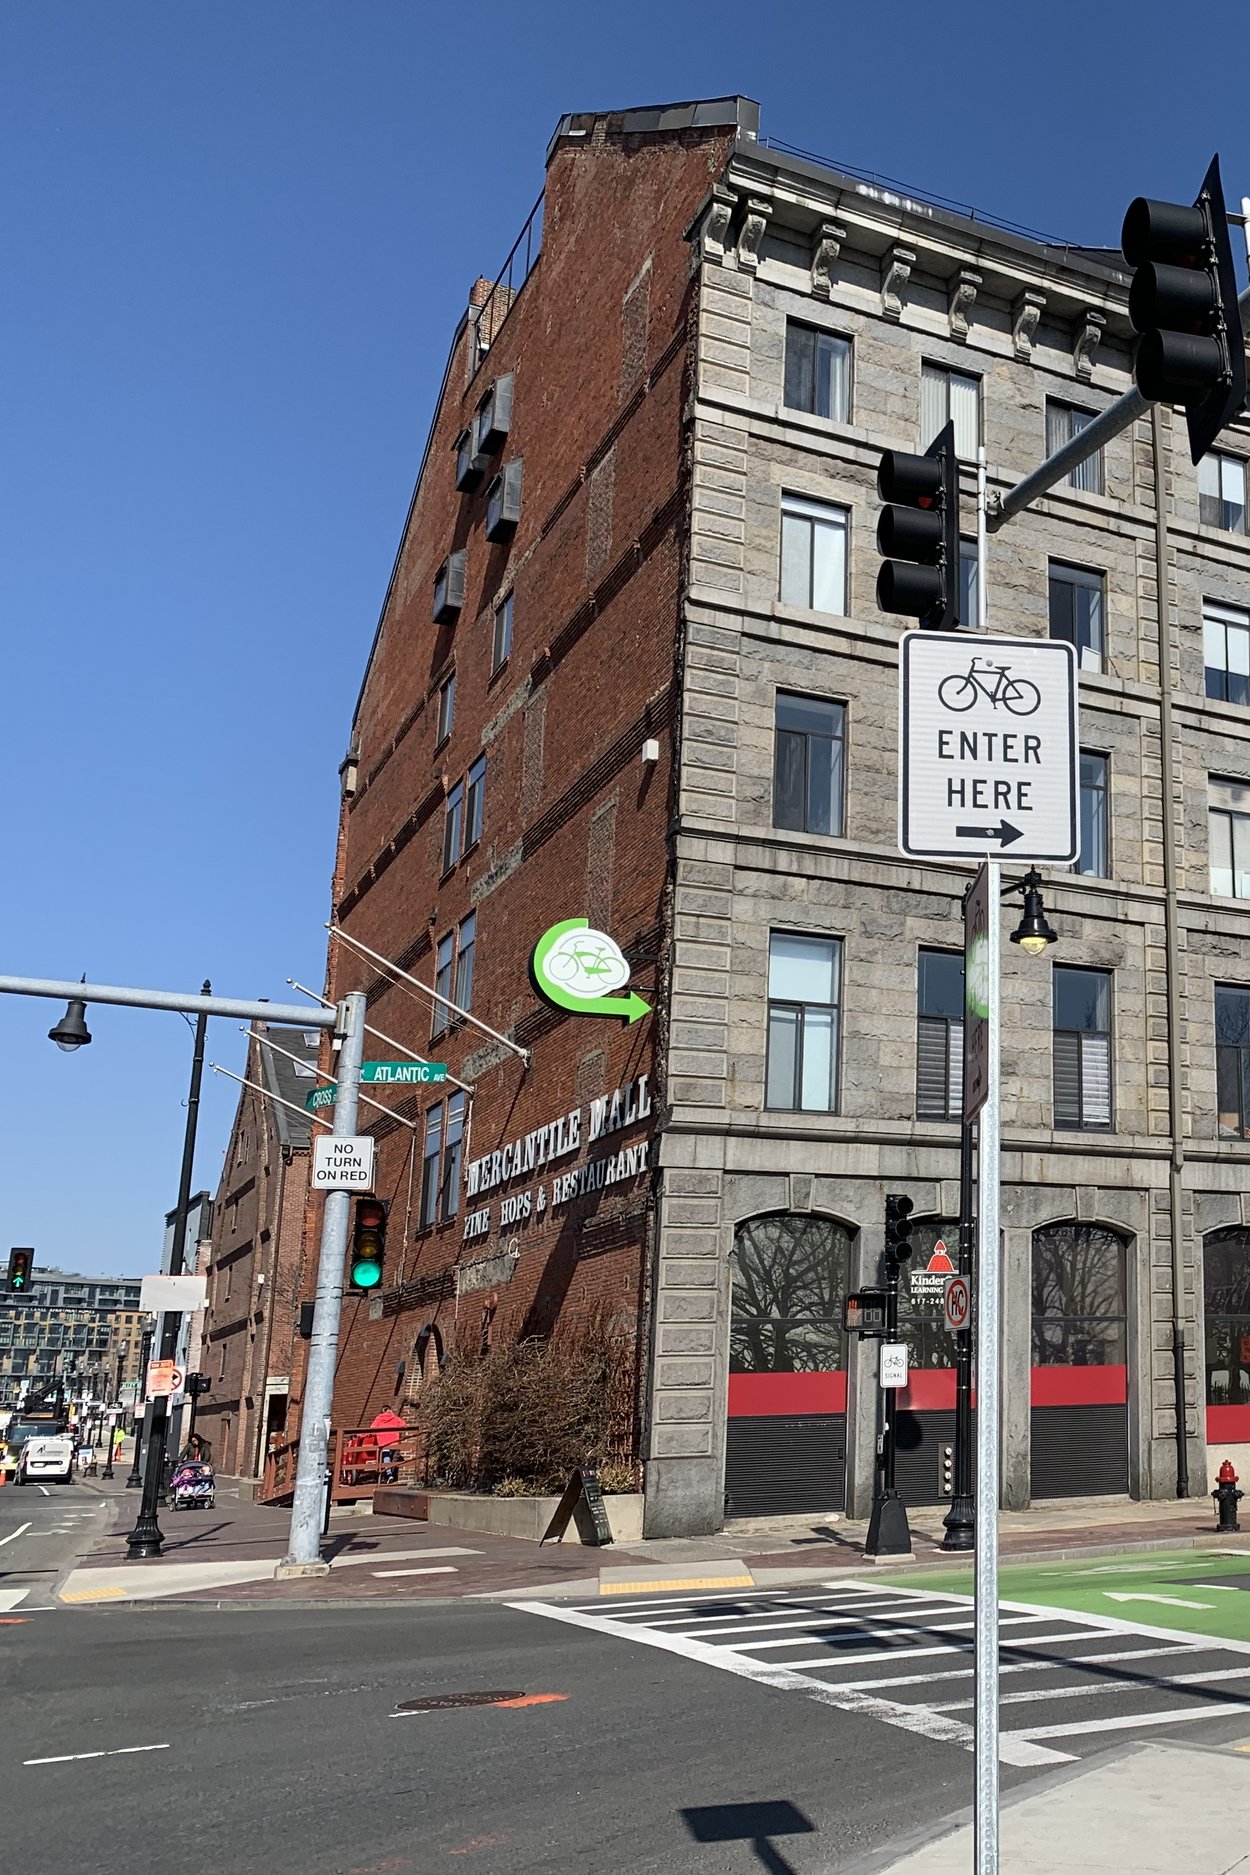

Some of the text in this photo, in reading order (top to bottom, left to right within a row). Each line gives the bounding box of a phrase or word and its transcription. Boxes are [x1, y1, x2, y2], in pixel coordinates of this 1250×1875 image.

[937, 729, 1042, 764] ENTER
[947, 777, 1033, 811] HERE
[374, 1066, 445, 1082] ATLANTIC AVE
[312, 1088, 333, 1107] CROSS
[466, 1074, 651, 1198] MERCANTILE MALL
[333, 1144, 354, 1155] NO
[325, 1157, 362, 1168] TURN
[316, 1170, 368, 1181] ON RED
[536, 1185, 546, 1212] &
[551, 1141, 650, 1206] RESTAURANT
[910, 1275, 953, 1286] Kinder
